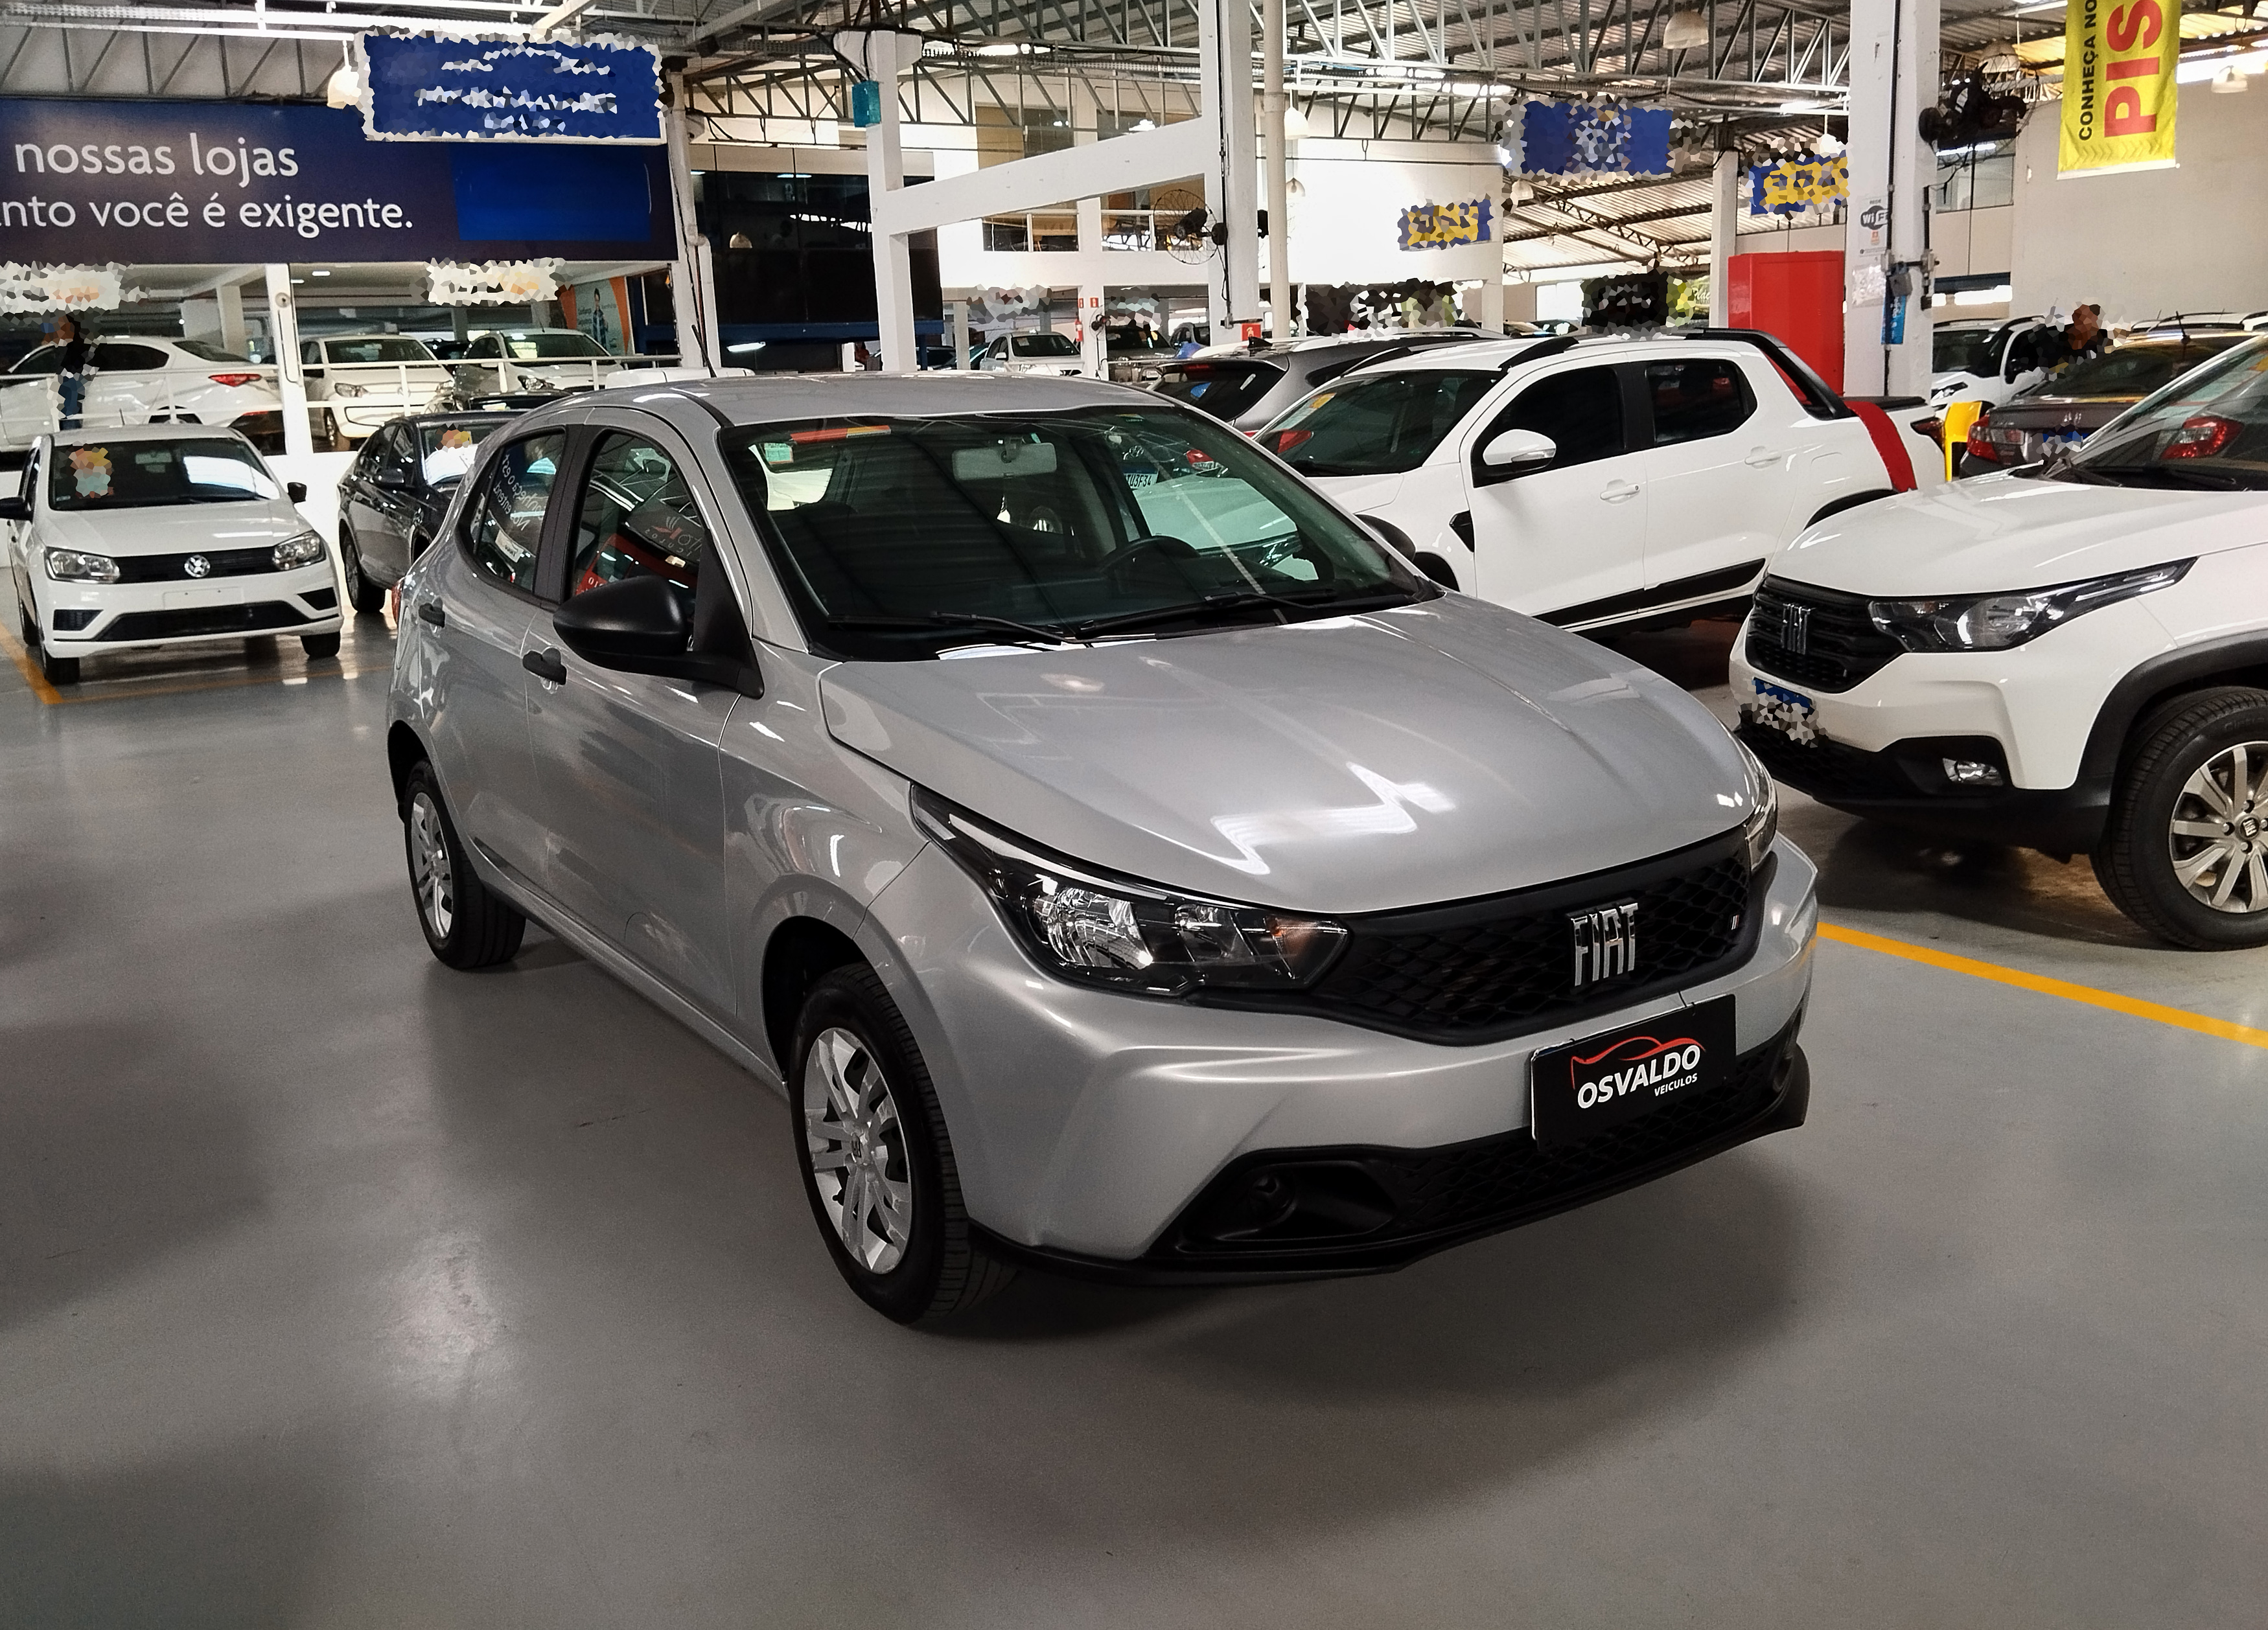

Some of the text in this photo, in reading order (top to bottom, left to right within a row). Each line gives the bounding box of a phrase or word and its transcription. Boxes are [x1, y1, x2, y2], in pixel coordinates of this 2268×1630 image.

[2079, 34, 2098, 141] CONHEÇA
[2104, 0, 2162, 137] PIS
[15, 132, 299, 188] nossas lojas
[0, 192, 413, 239] nto você é exigente.
[1571, 902, 1639, 987] FIAT
[1577, 1044, 1701, 1109] OSVALDO
[1654, 1073, 1698, 1097] VEICULOS
